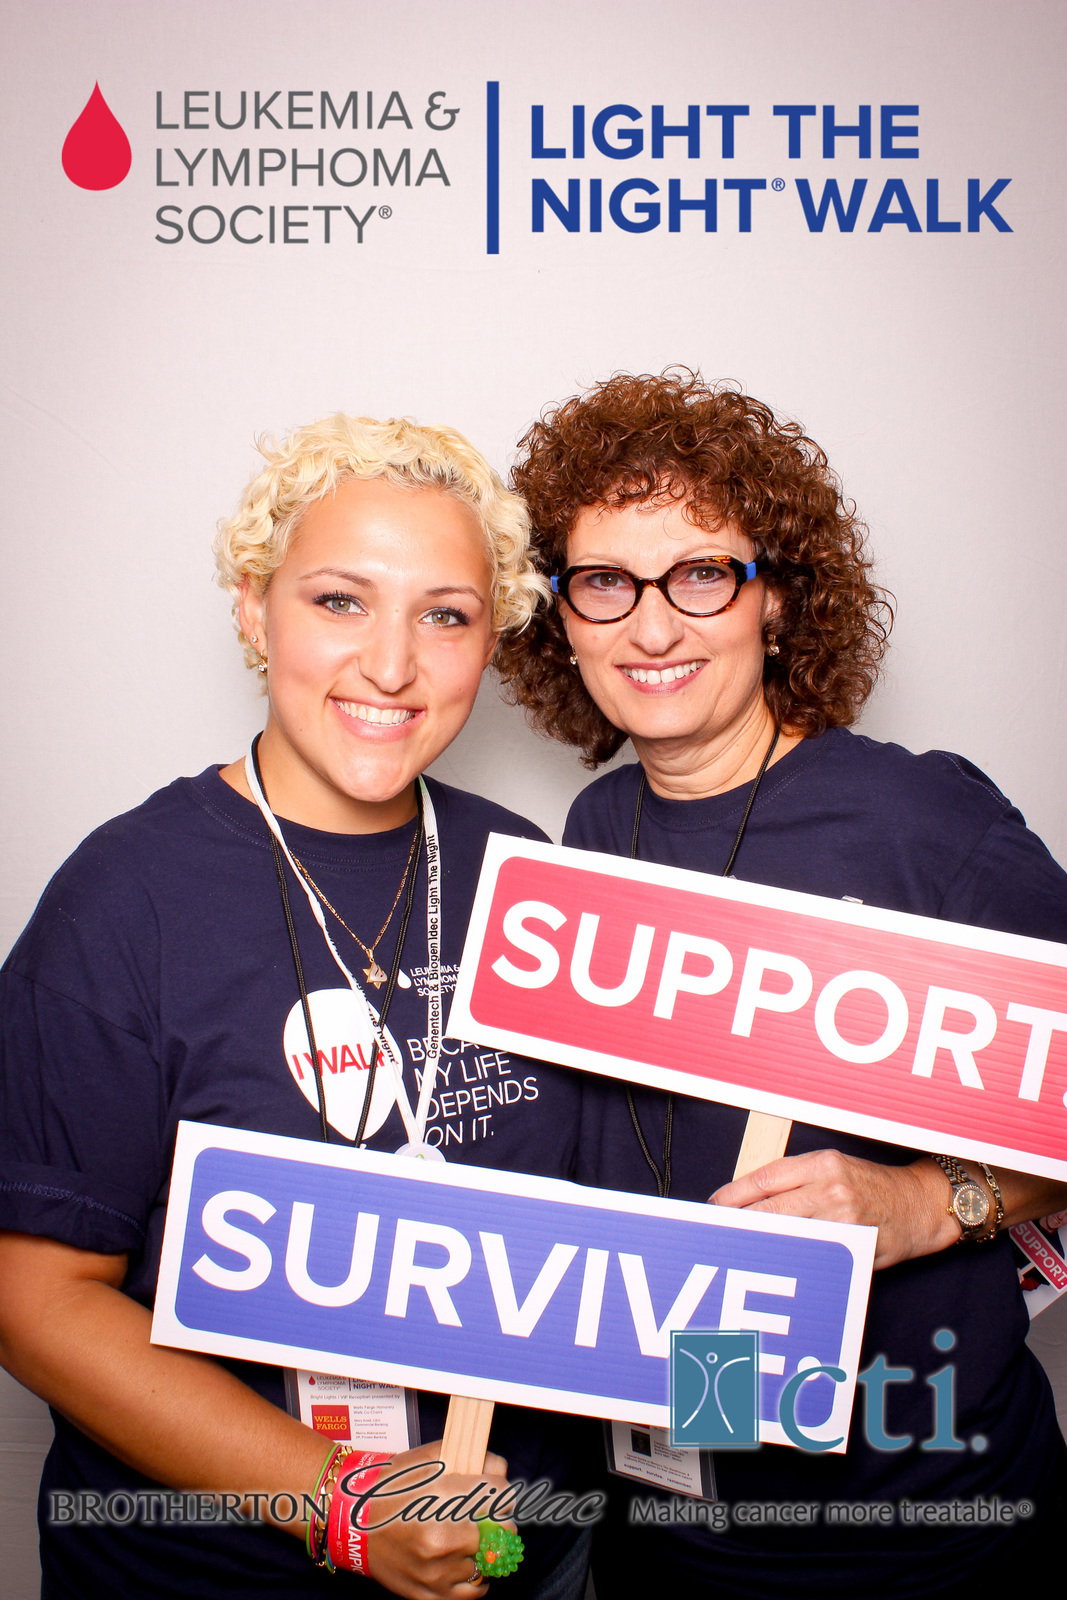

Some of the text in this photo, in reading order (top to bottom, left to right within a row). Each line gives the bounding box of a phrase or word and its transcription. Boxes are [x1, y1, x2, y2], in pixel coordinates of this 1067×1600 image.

[426, 834, 441, 1059] Genentech & Biogen Idec Light The Night
[409, 964, 454, 978] LEUMIA
[490, 900, 1067, 1109] SUPPORT
[291, 1054, 305, 1081] I
[459, 1051, 512, 1083] LIFE
[426, 1076, 539, 1122] DEPENDS
[424, 1114, 495, 1148] ON IT.
[353, 1382, 376, 1390] NIGHT
[313, 1415, 348, 1423] WELLS
[315, 1423, 348, 1431] FARGO
